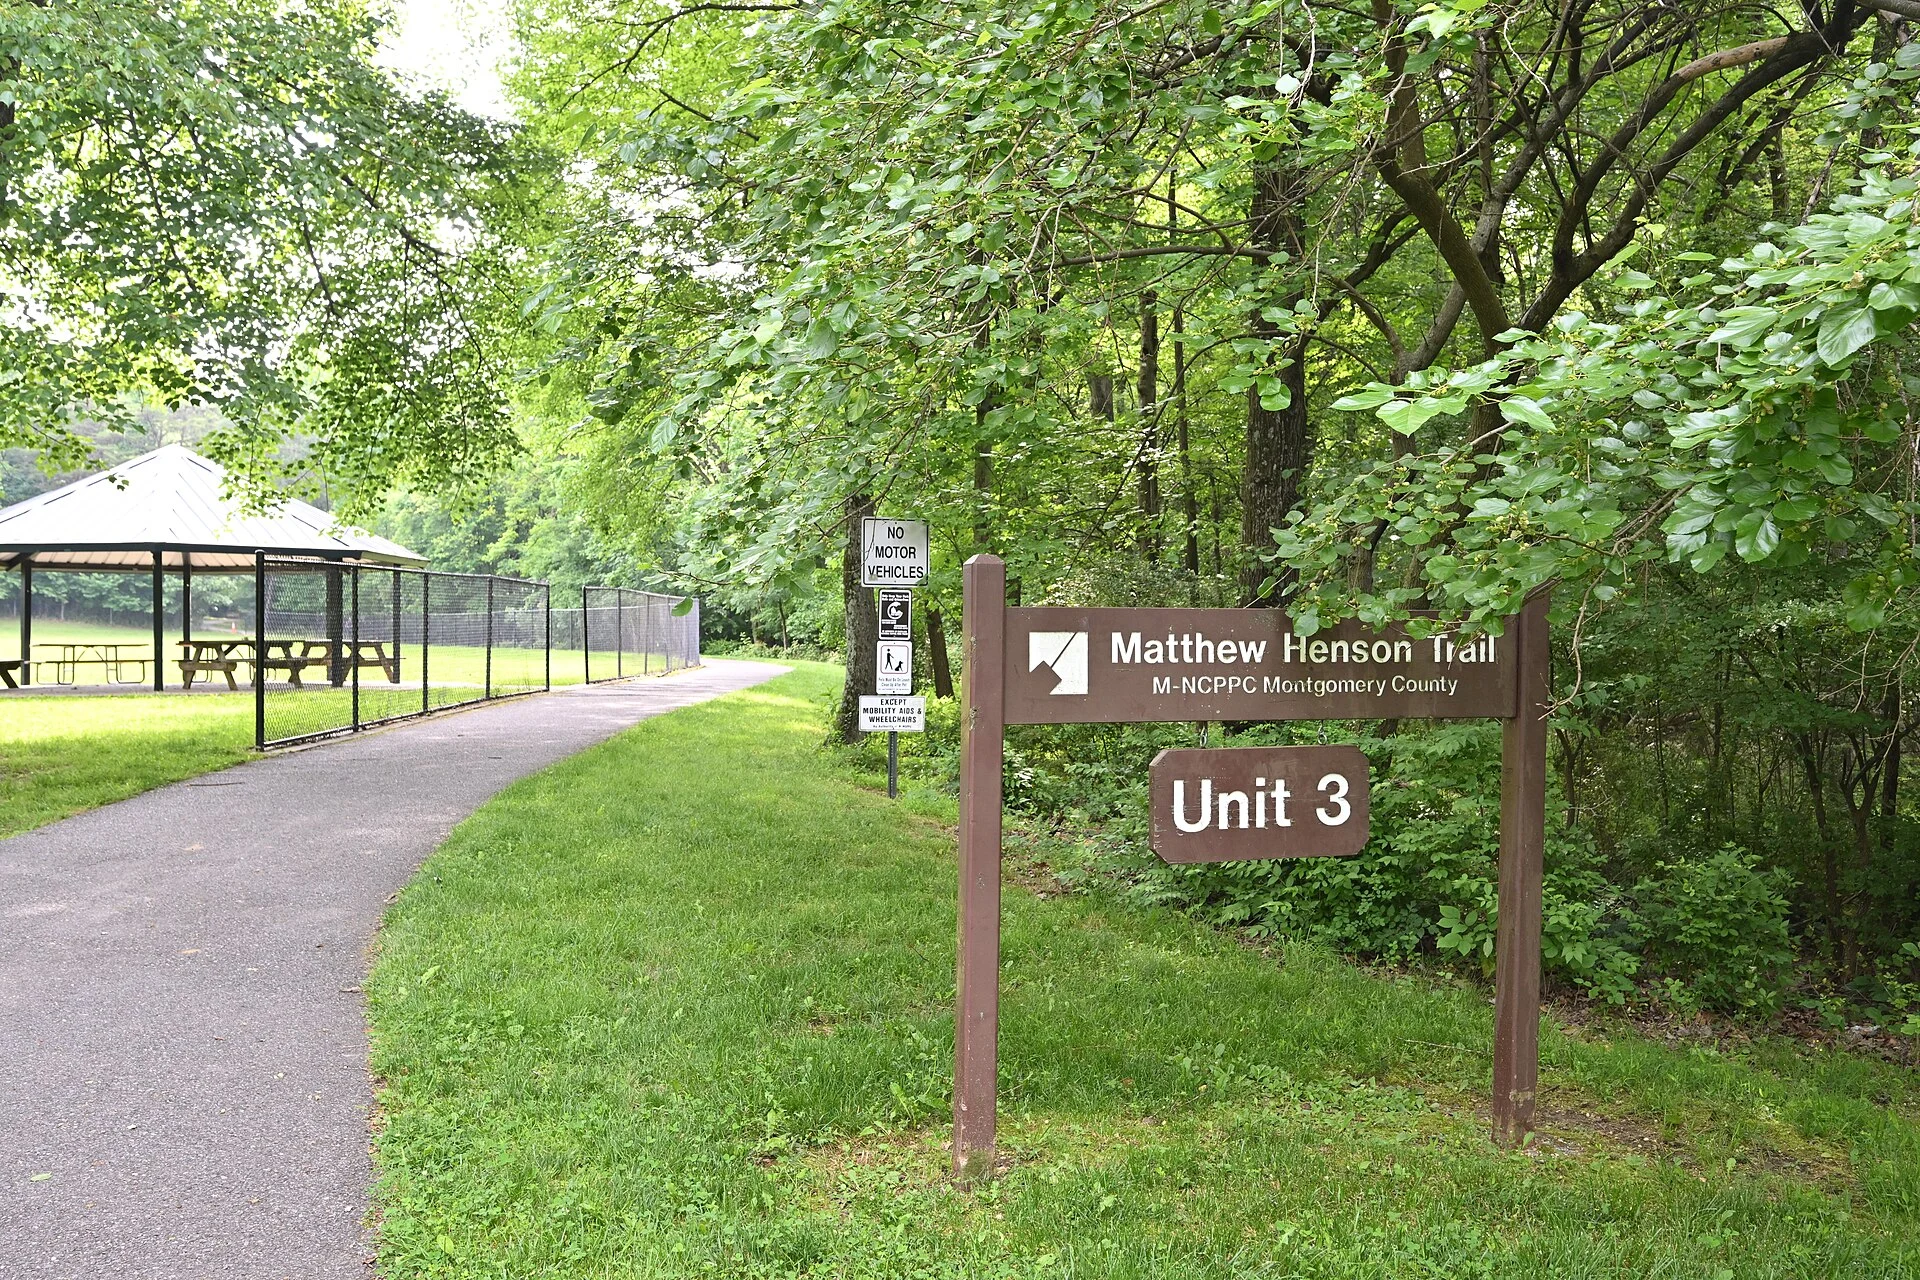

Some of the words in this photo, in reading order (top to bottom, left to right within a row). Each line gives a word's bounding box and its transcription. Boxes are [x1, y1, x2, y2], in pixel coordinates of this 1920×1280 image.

[887, 526, 905, 539] NO
[875, 546, 917, 559] MOTOR
[868, 565, 924, 579] VEHICLES
[1111, 631, 1267, 664] Matthew
[1283, 632, 1413, 664] Henson
[1427, 632, 1496, 664] Trail
[1152, 676, 1258, 695] M-NCPPC
[1263, 675, 1387, 697] Montgomery
[1391, 674, 1458, 696] County
[880, 698, 907, 706] EXCEPT
[862, 707, 896, 715] MOBILITY
[899, 707, 915, 715] AIDS
[917, 707, 922, 715] &
[868, 715, 917, 723] WHEELCHAIRS
[1173, 777, 1292, 833] Unit
[1315, 773, 1351, 826] 3
